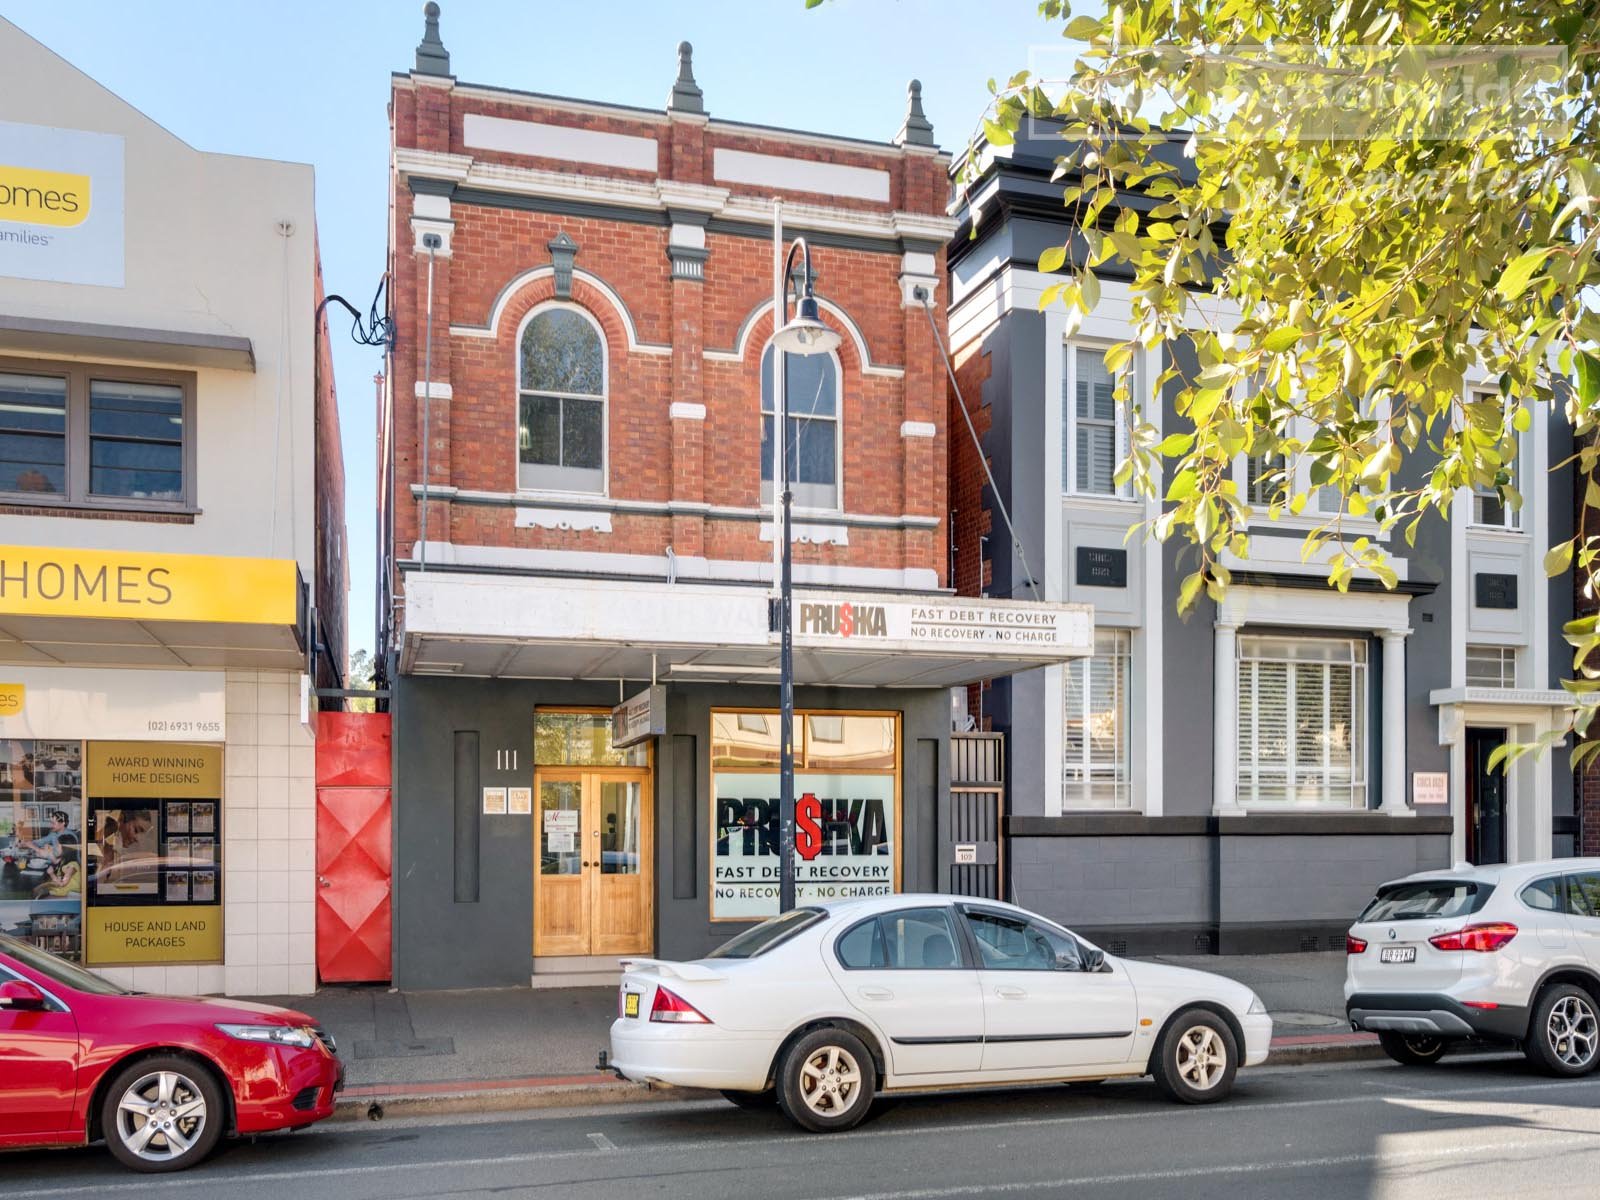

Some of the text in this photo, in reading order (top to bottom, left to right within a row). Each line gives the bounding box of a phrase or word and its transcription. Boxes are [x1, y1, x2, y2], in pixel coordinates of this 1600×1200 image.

[0, 560, 172, 605] HOMES
[911, 608, 1057, 625] FAST DEBT RECOVERY
[911, 627, 1057, 642] NO RECOVERY NO CHARGE
[148, 721, 220, 732] (02) 6931 9655
[107, 756, 205, 768] AWARD WINNING
[112, 772, 200, 784] HOME DESIGNS
[715, 865, 890, 878] FAST DET RECOVERY
[715, 888, 735, 898] NO
[739, 887, 804, 898] RECOVY
[817, 887, 836, 898] NO
[104, 920, 207, 933] HOUSE AND LAND
[125, 936, 186, 948] PACKAGES
